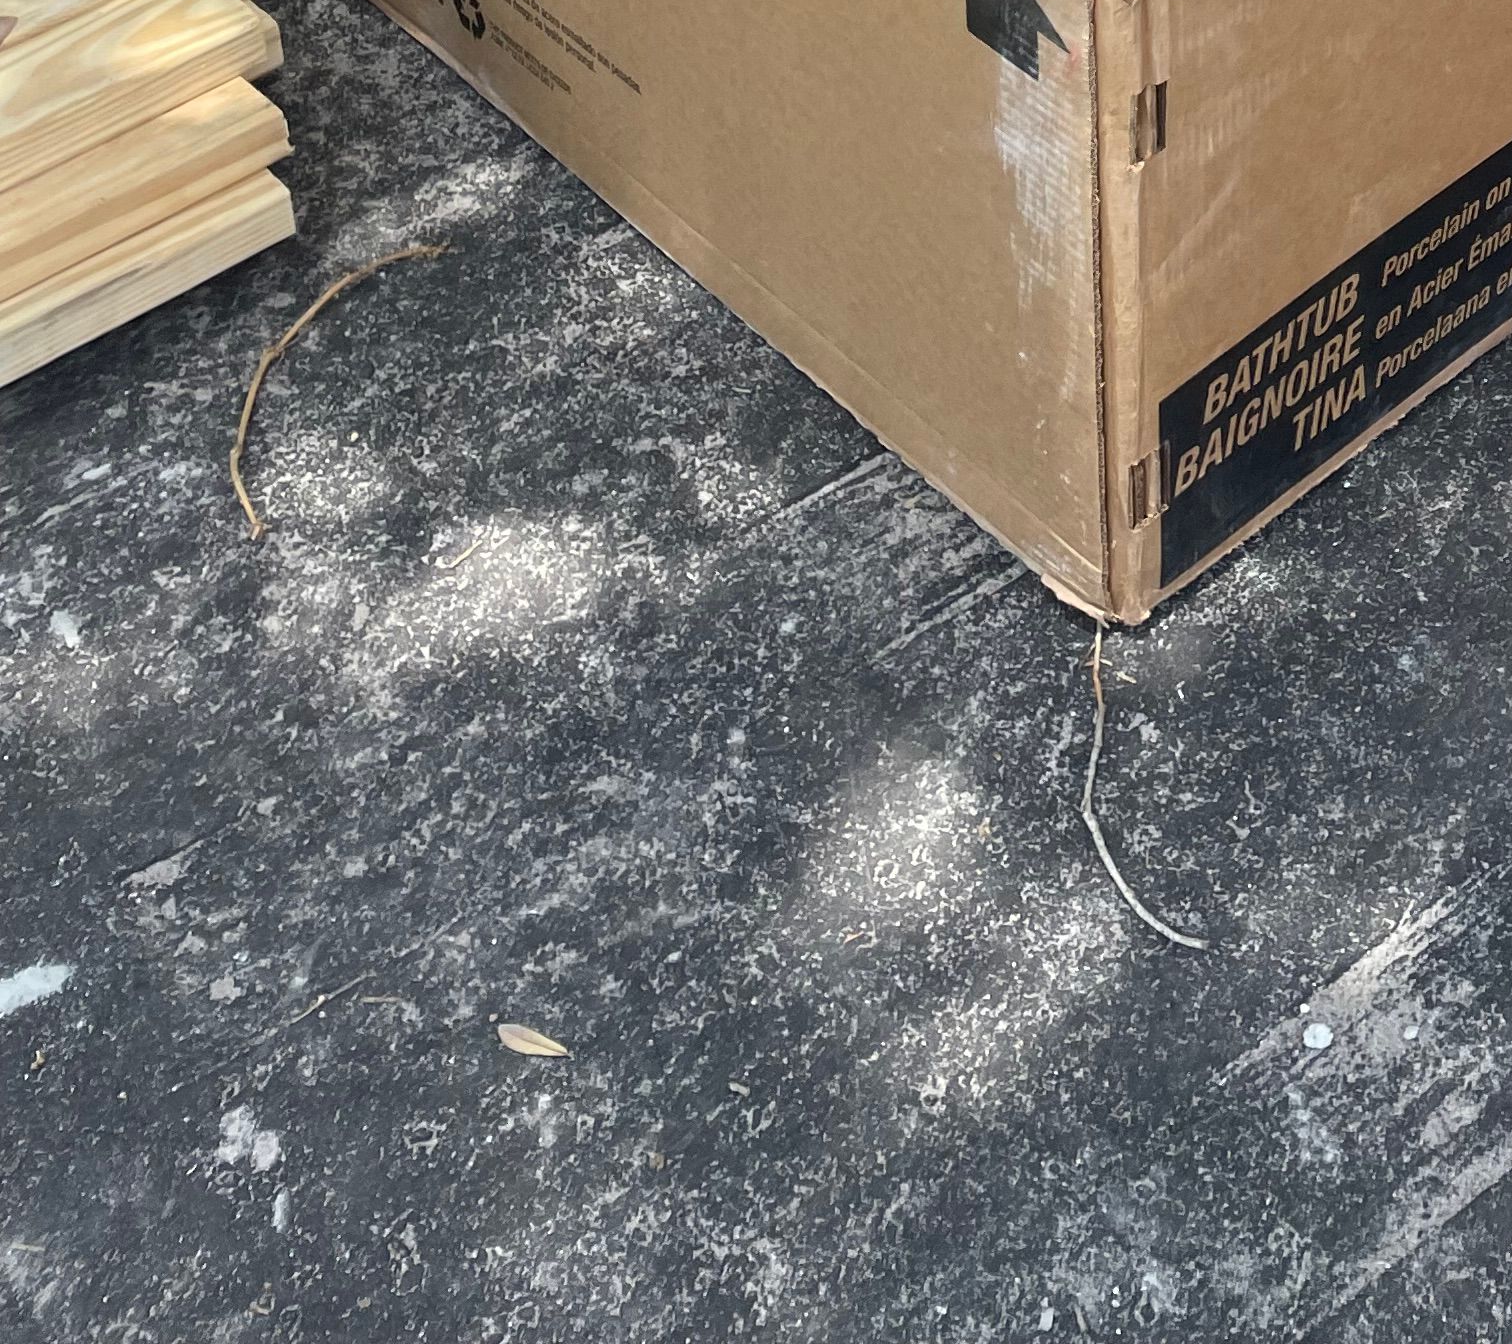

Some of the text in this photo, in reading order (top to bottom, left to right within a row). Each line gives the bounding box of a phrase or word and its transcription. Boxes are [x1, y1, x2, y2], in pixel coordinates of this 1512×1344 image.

[1174, 313, 1364, 498] BAIGNOIRE
[1374, 304, 1402, 341] en
[1406, 257, 1464, 324] Acier
[1203, 272, 1361, 426] BATHTUB
[1382, 198, 1480, 288] Porcelain
[1485, 178, 1512, 208] on
[1292, 364, 1367, 452] TINA
[1375, 284, 1490, 388] Porcelaana
